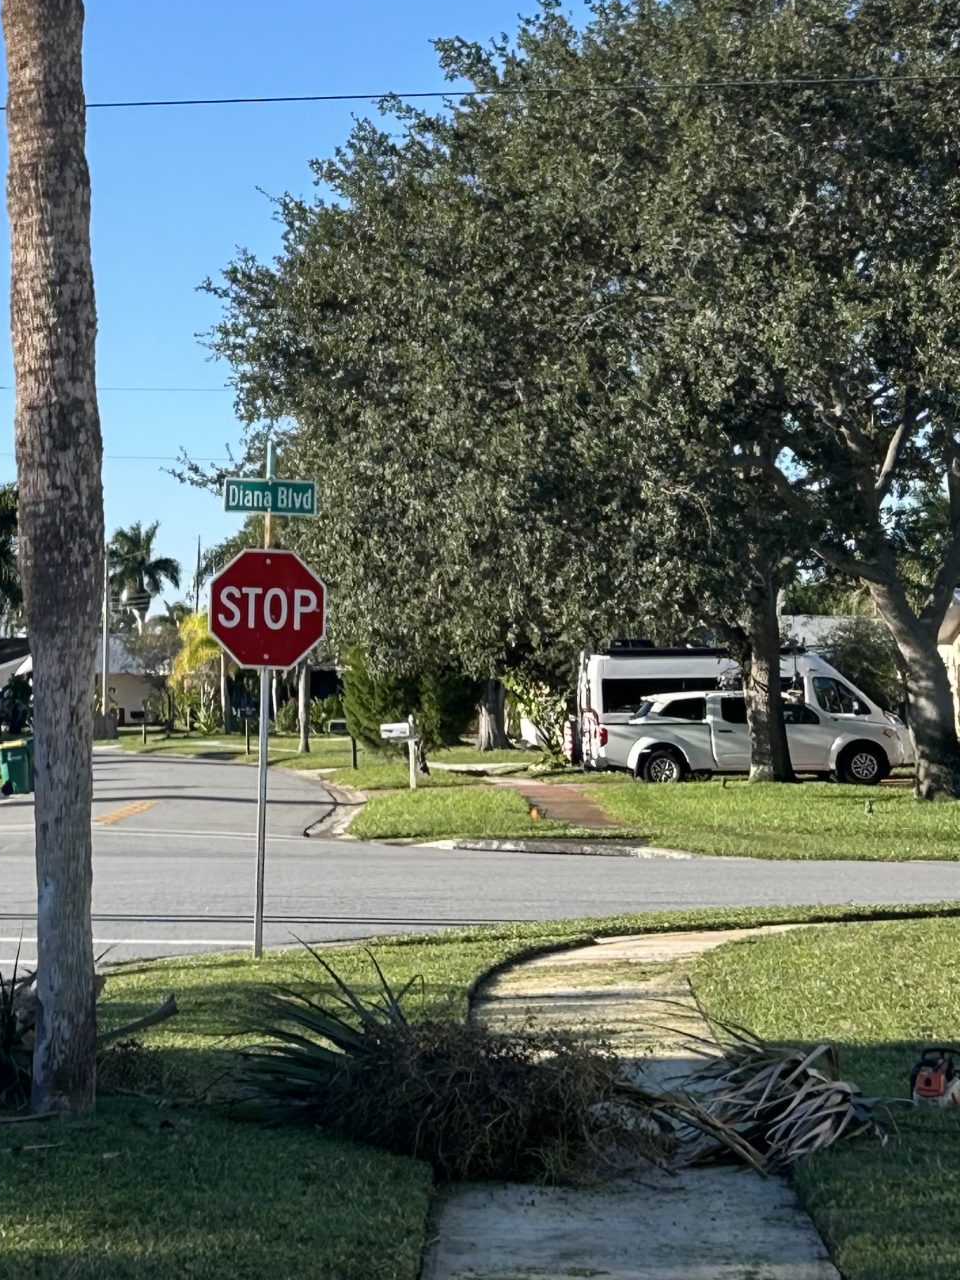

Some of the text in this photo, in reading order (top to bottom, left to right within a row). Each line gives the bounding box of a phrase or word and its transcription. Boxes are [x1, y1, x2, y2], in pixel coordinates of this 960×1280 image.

[229, 485, 312, 510] Diana Blvd
[218, 586, 318, 631] STOP
